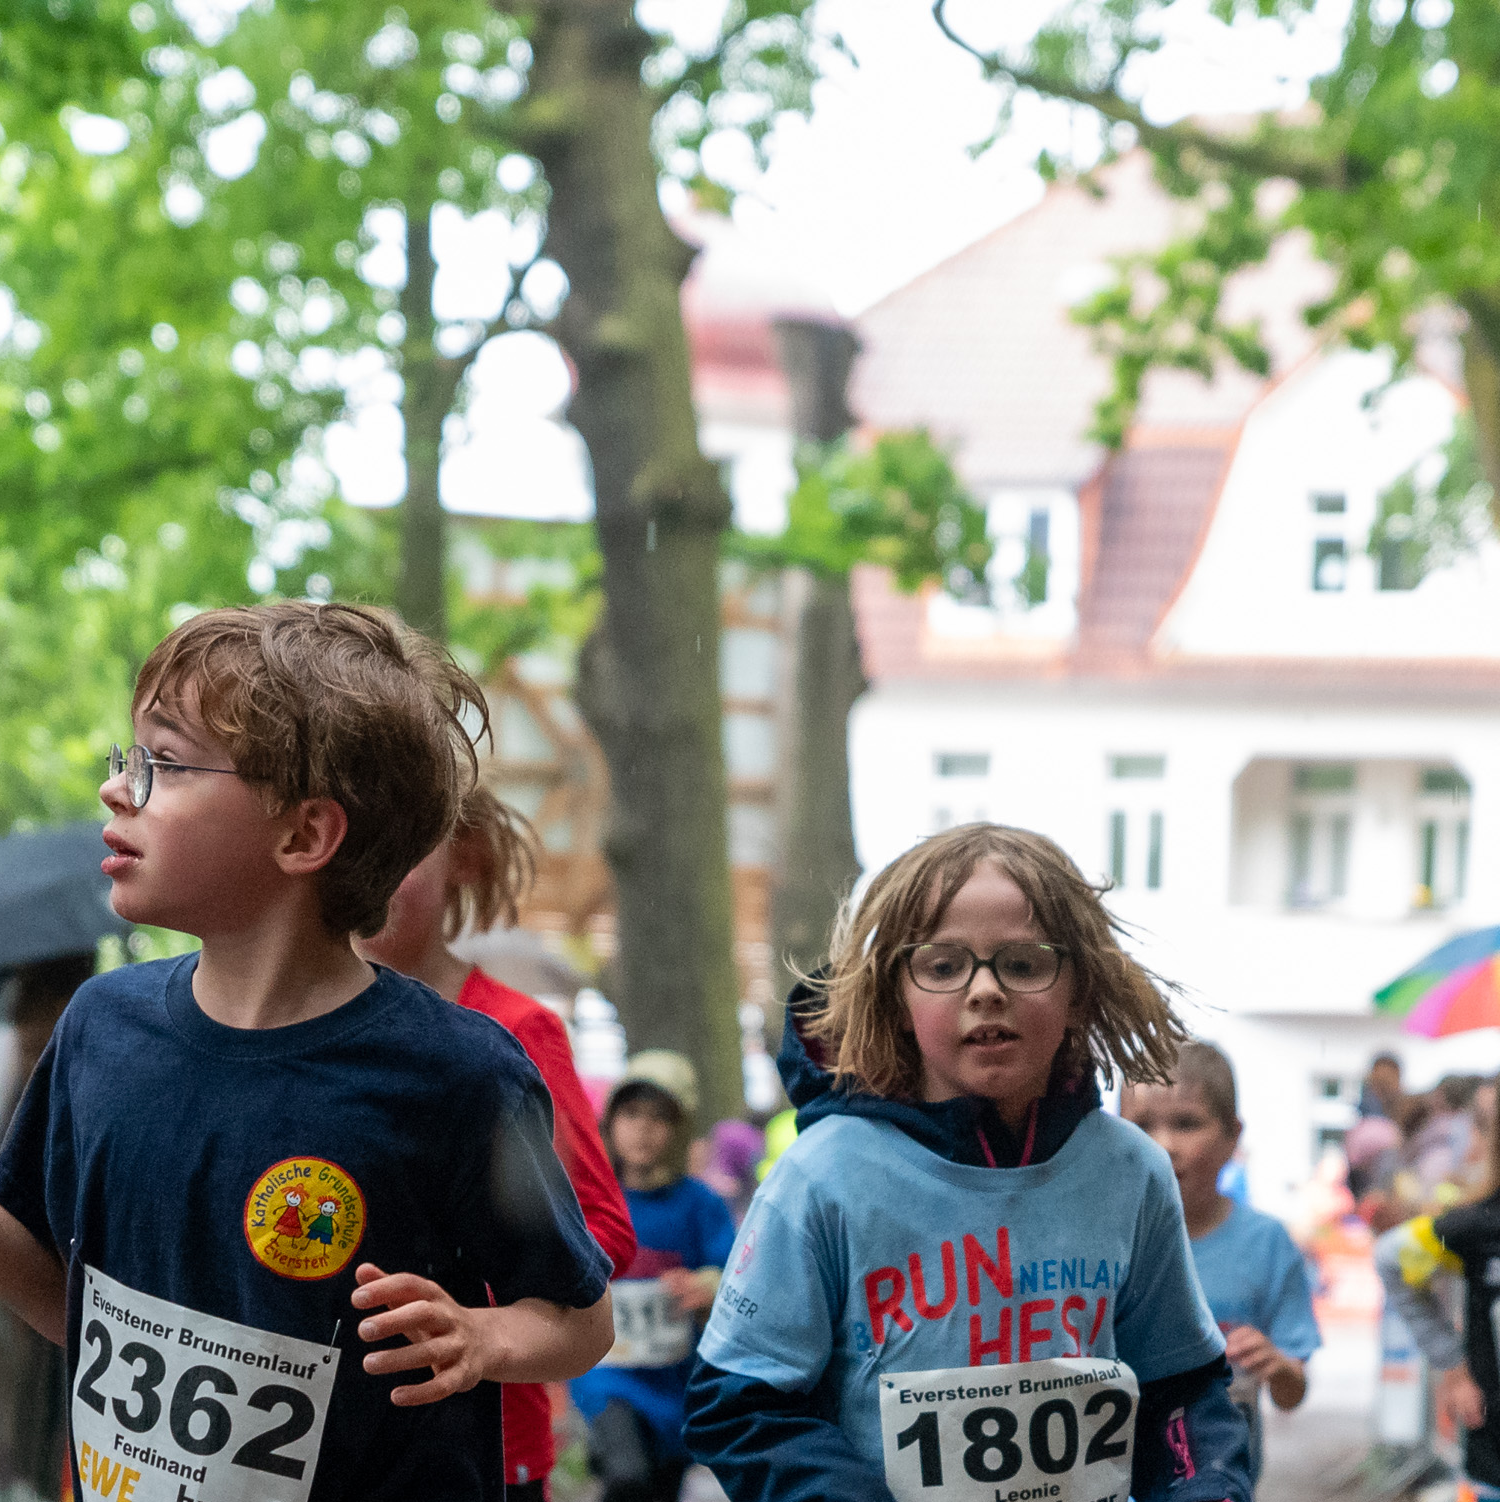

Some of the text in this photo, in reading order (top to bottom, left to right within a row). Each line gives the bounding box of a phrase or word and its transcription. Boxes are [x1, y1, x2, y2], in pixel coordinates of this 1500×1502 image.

[252, 1163, 360, 1249] Katholische Grundschule
[263, 1241, 328, 1270] Eversten
[92, 1288, 318, 1381] Everstener Brunnenlauf
[76, 1318, 316, 1481] 2362
[899, 1366, 1122, 1405] Everstener Brunnenlauf
[113, 1433, 208, 1484] Ferdinand
[896, 1388, 1133, 1488] 1802
